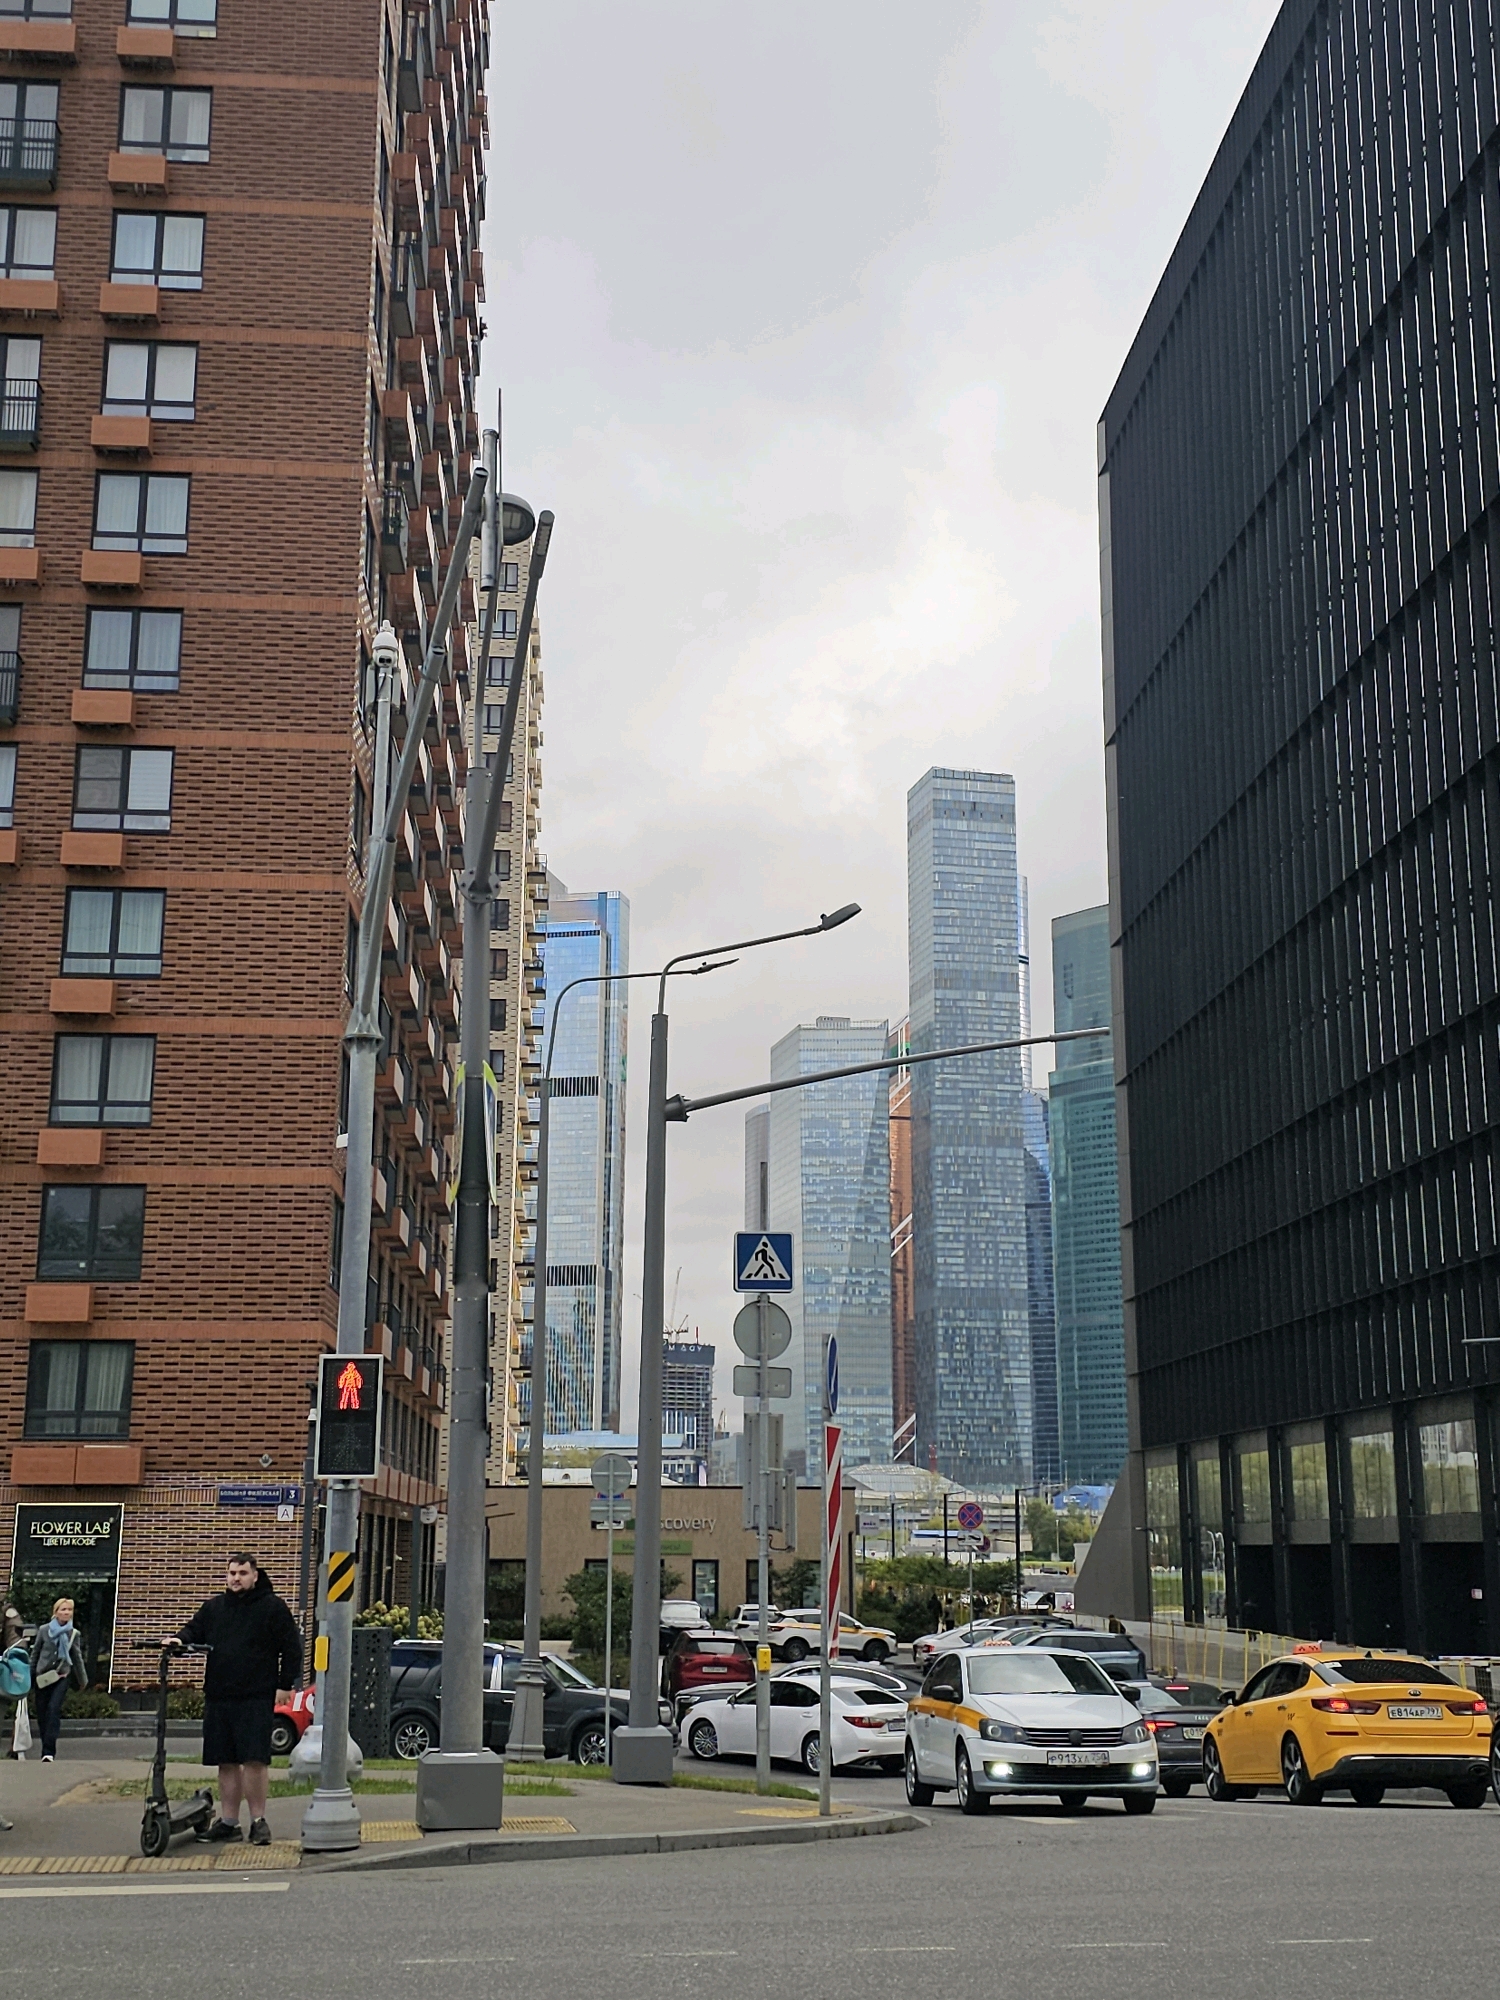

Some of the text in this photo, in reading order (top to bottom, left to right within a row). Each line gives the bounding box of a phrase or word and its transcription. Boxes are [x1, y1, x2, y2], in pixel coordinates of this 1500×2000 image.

[289, 1490, 295, 1499] 3
[30, 1521, 111, 1534] FLOWER LAB
[43, 1537, 97, 1547] ЦВЕТЫ КОФЕ
